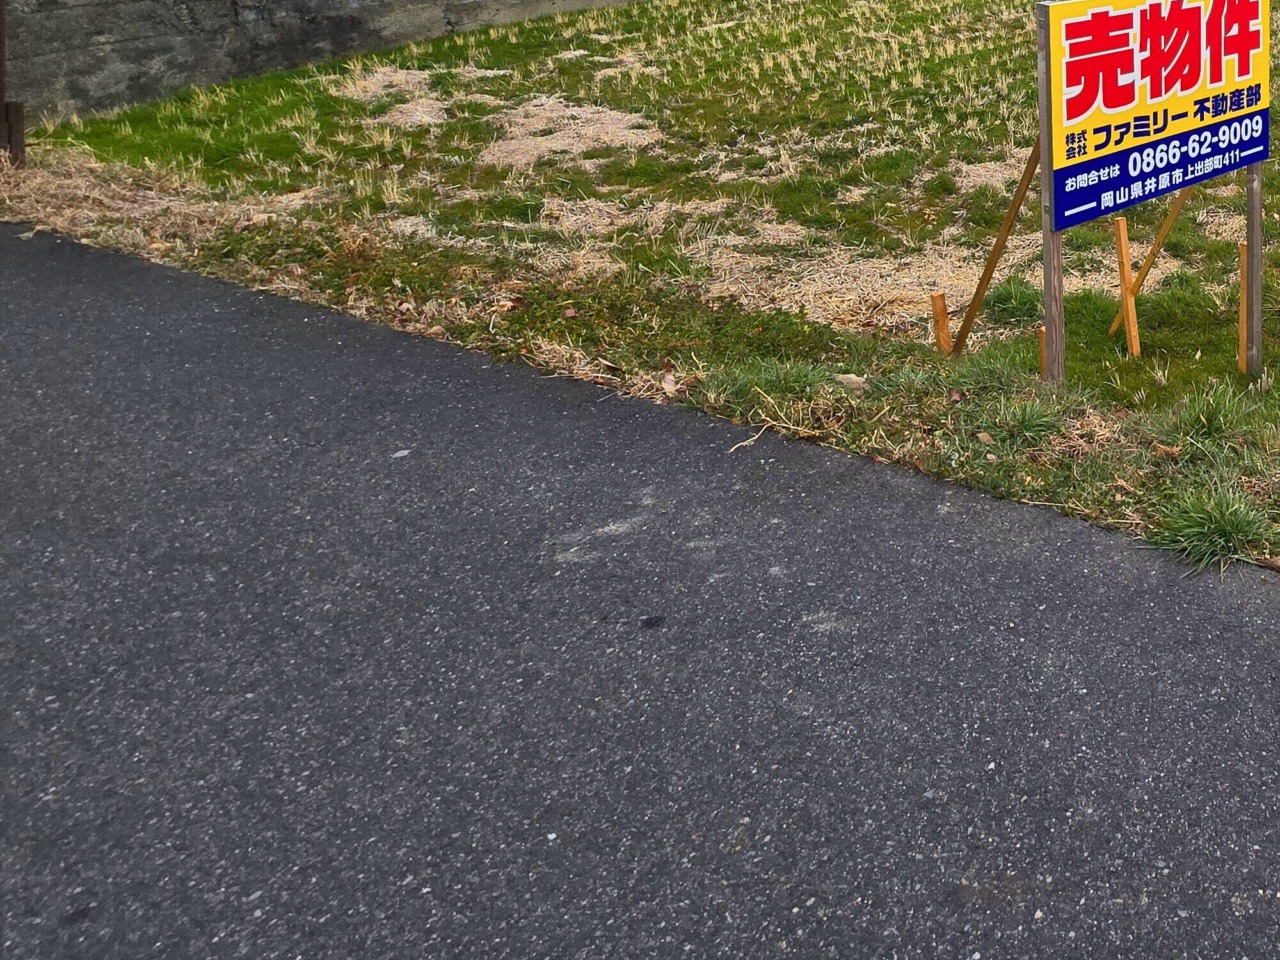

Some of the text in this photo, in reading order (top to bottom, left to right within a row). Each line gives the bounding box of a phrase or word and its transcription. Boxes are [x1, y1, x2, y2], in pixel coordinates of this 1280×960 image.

[1065, 115, 1262, 193] お問合せは 0866-62-9009
